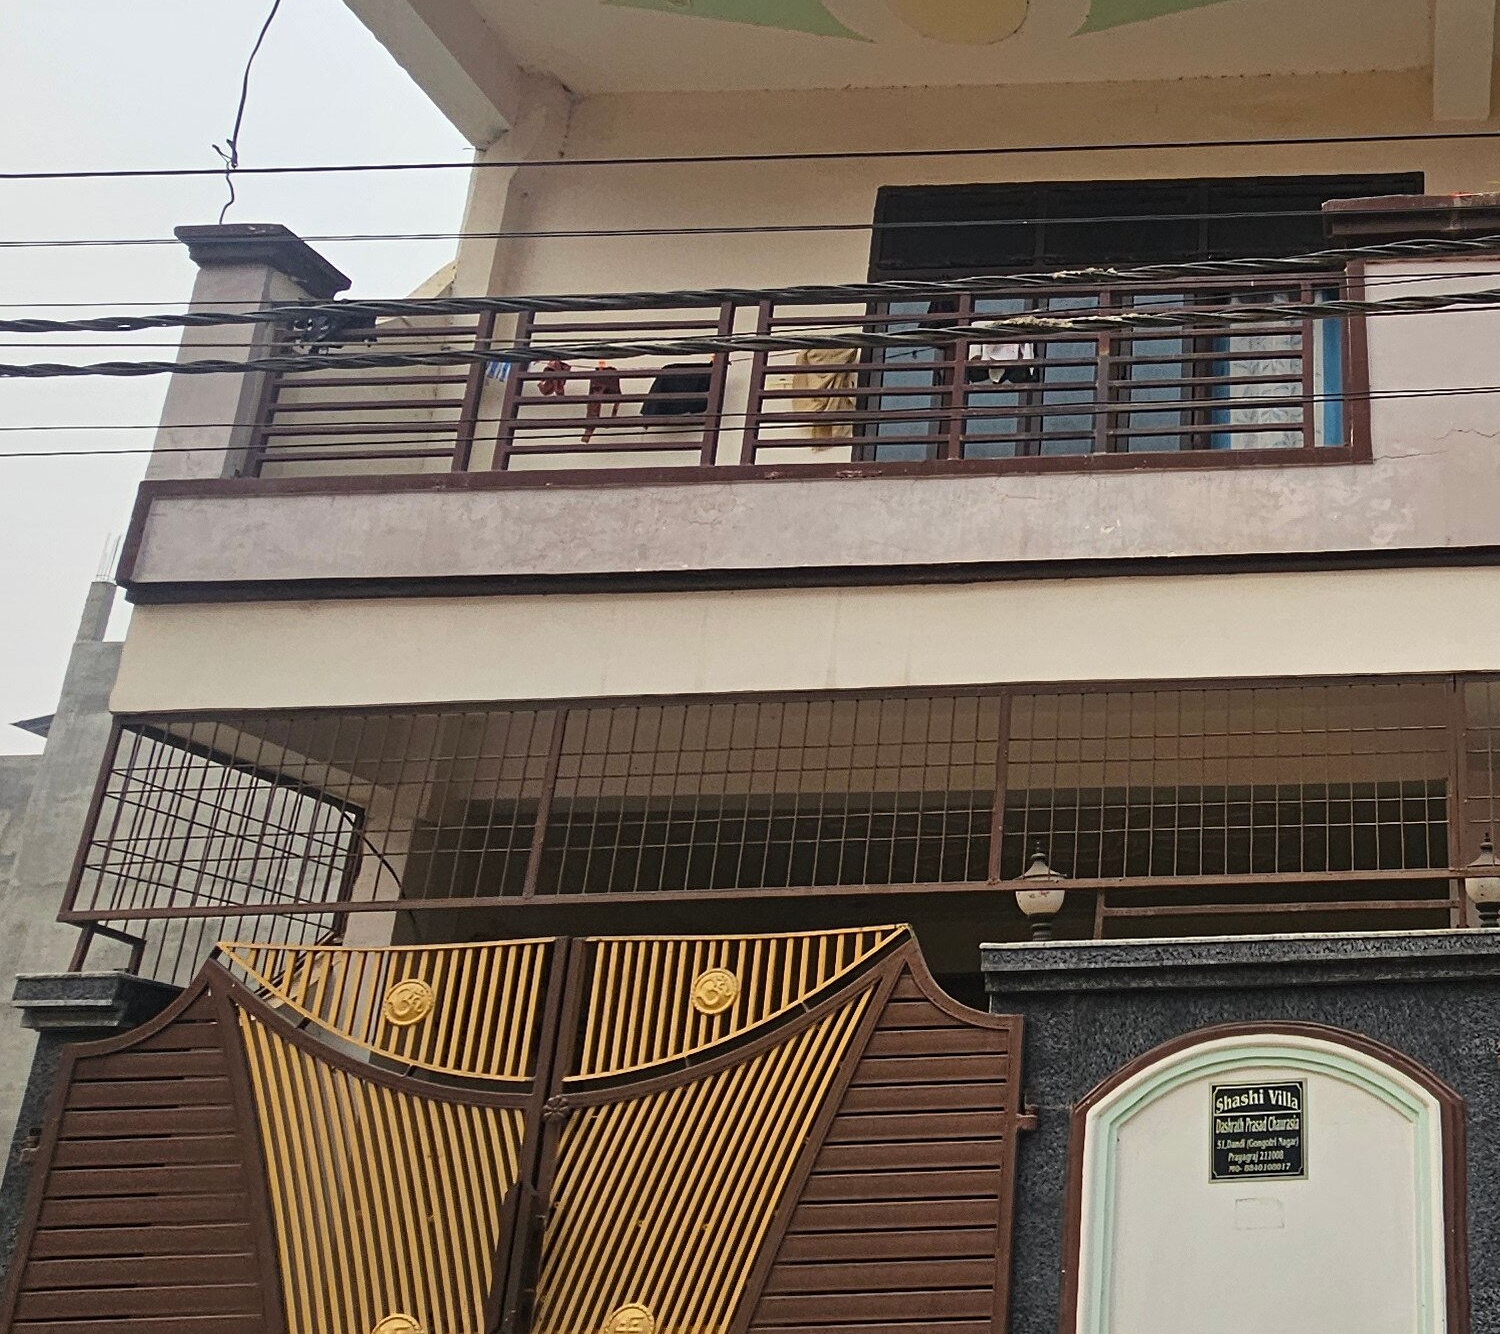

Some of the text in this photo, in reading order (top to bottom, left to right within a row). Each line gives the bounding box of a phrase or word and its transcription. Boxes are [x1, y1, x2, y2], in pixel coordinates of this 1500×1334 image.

[1216, 1089, 1299, 1114] Shashi Villa
[1245, 1116, 1267, 1132] Prasad
